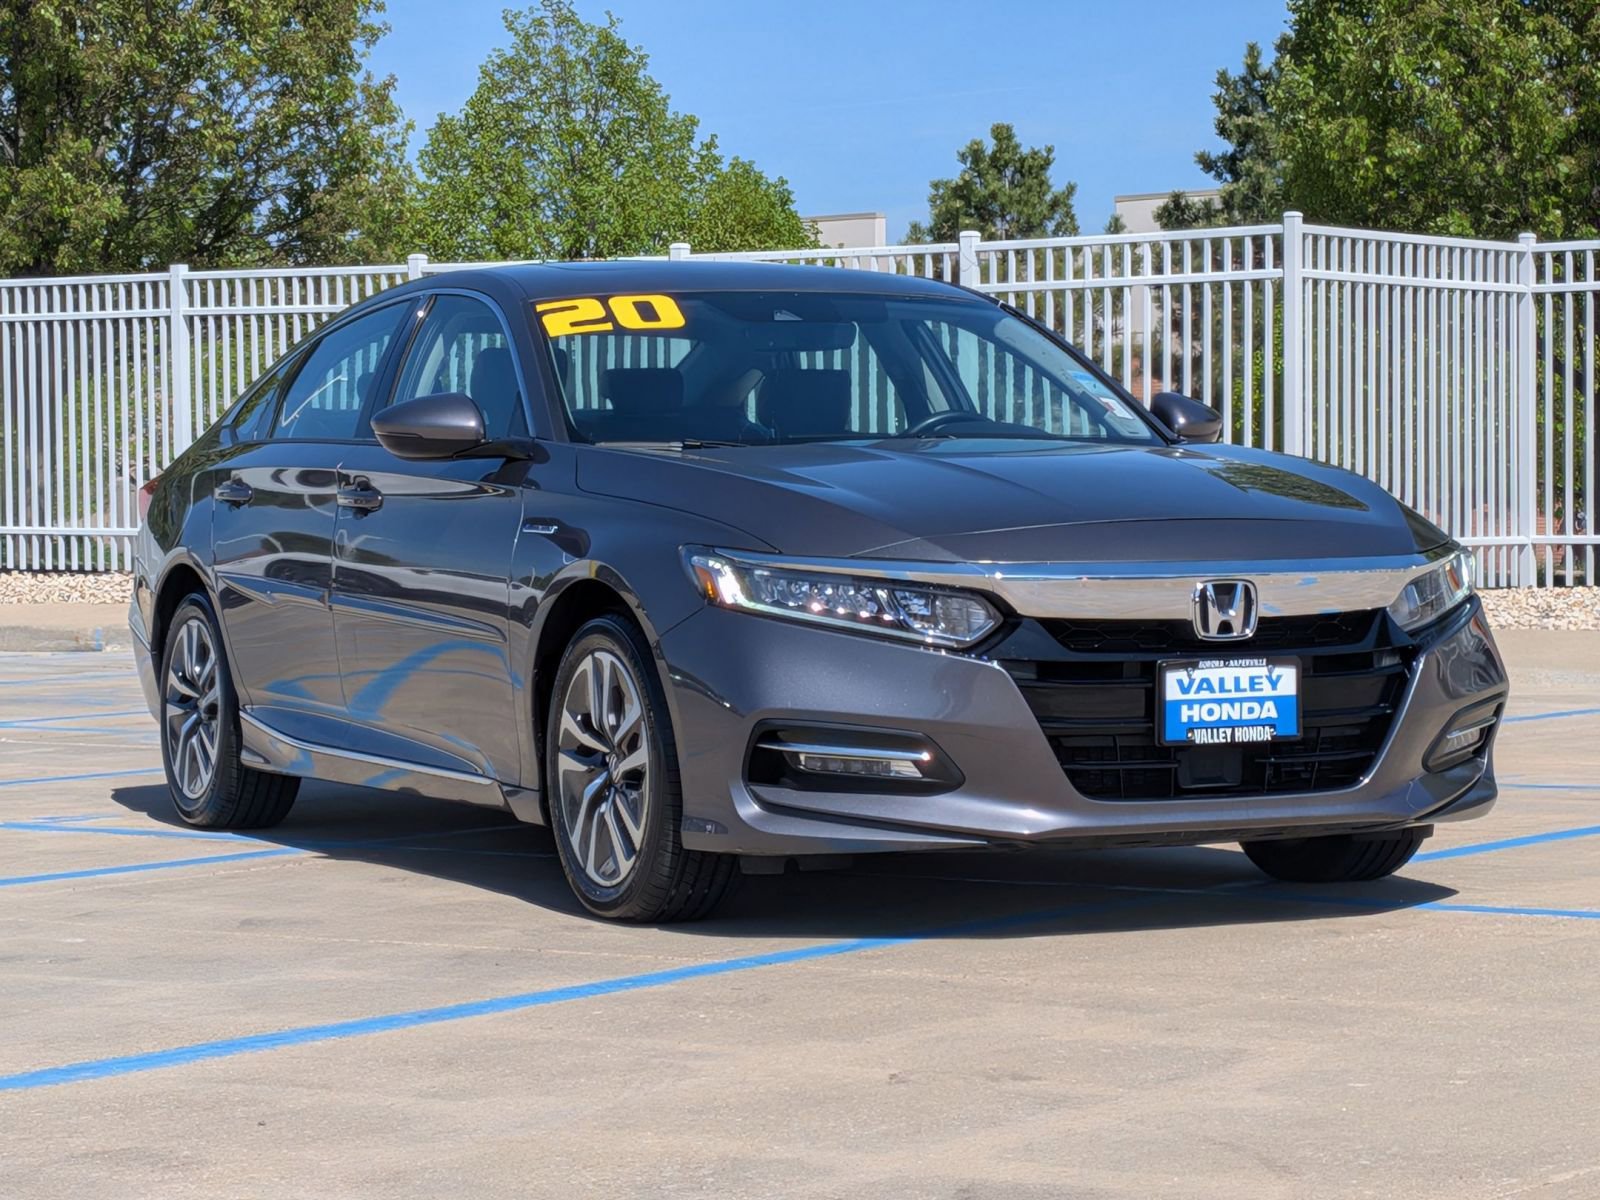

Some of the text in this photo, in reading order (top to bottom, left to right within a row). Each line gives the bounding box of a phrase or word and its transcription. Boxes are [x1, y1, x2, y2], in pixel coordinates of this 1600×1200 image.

[535, 294, 686, 337] 20
[1176, 674, 1283, 694] VALLEY
[1181, 701, 1278, 723] HONDA
[1194, 726, 1271, 744] VALLEY HONDA
